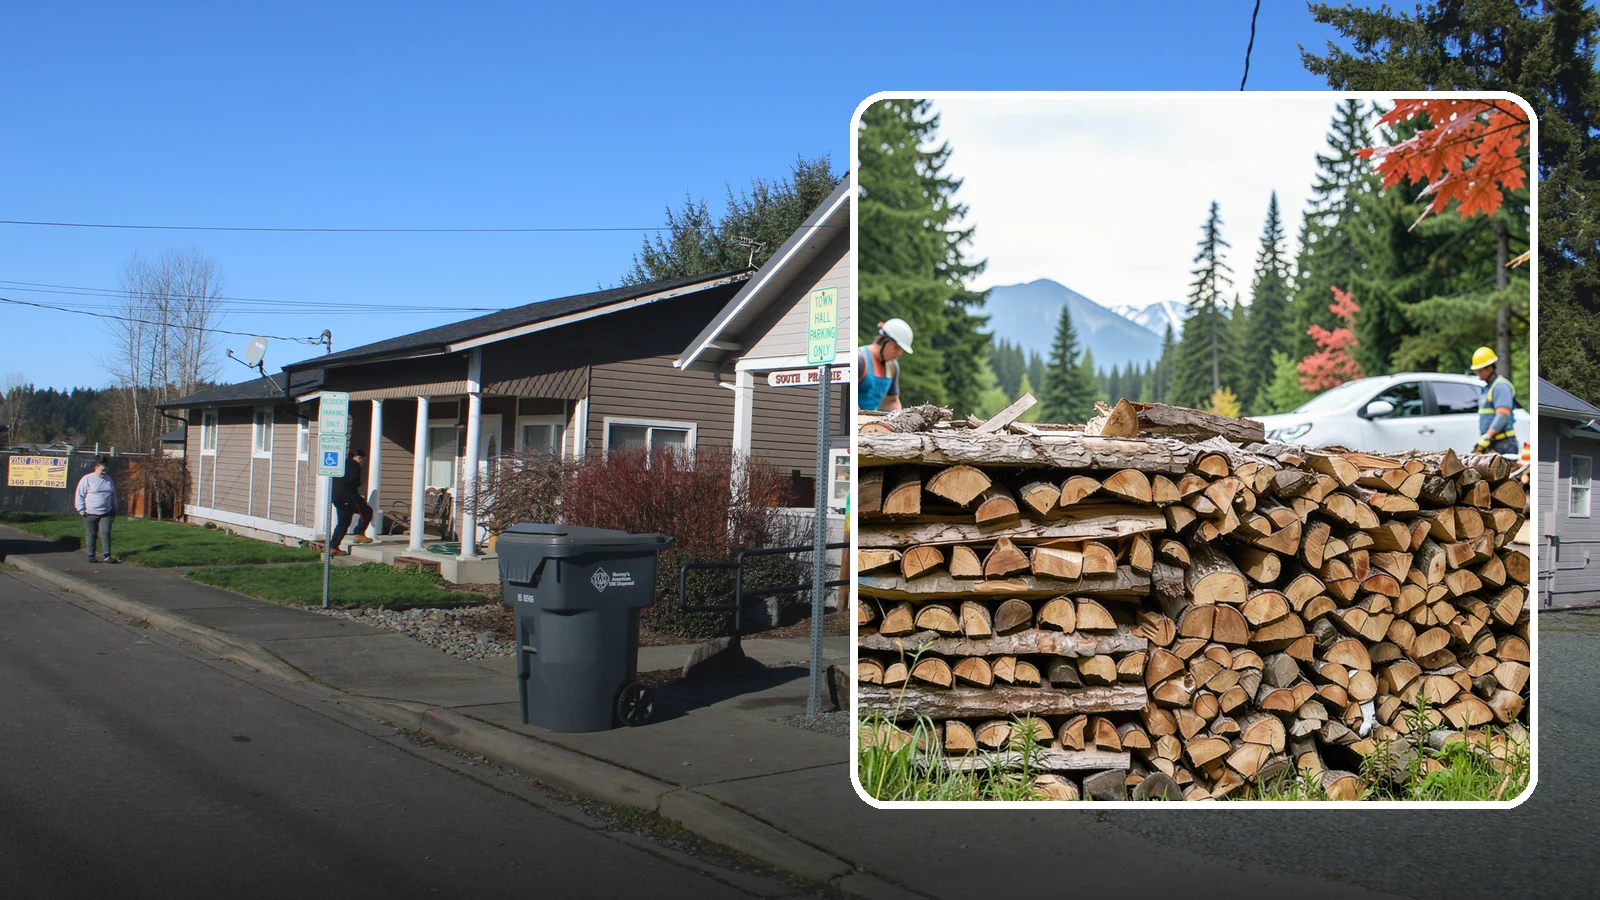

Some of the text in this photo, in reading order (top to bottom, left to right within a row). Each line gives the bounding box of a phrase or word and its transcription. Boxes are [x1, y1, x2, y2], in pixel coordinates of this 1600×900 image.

[815, 294, 833, 308] TOWN
[814, 311, 831, 324] HALL
[810, 326, 836, 340] PARKING
[813, 344, 831, 357] ONLY
[775, 373, 801, 384] SOUTH
[322, 409, 345, 417] PARKING
[325, 420, 341, 428] ONLY
[320, 436, 344, 444] RESERVED
[10, 479, 65, 487] 360-897-8625
